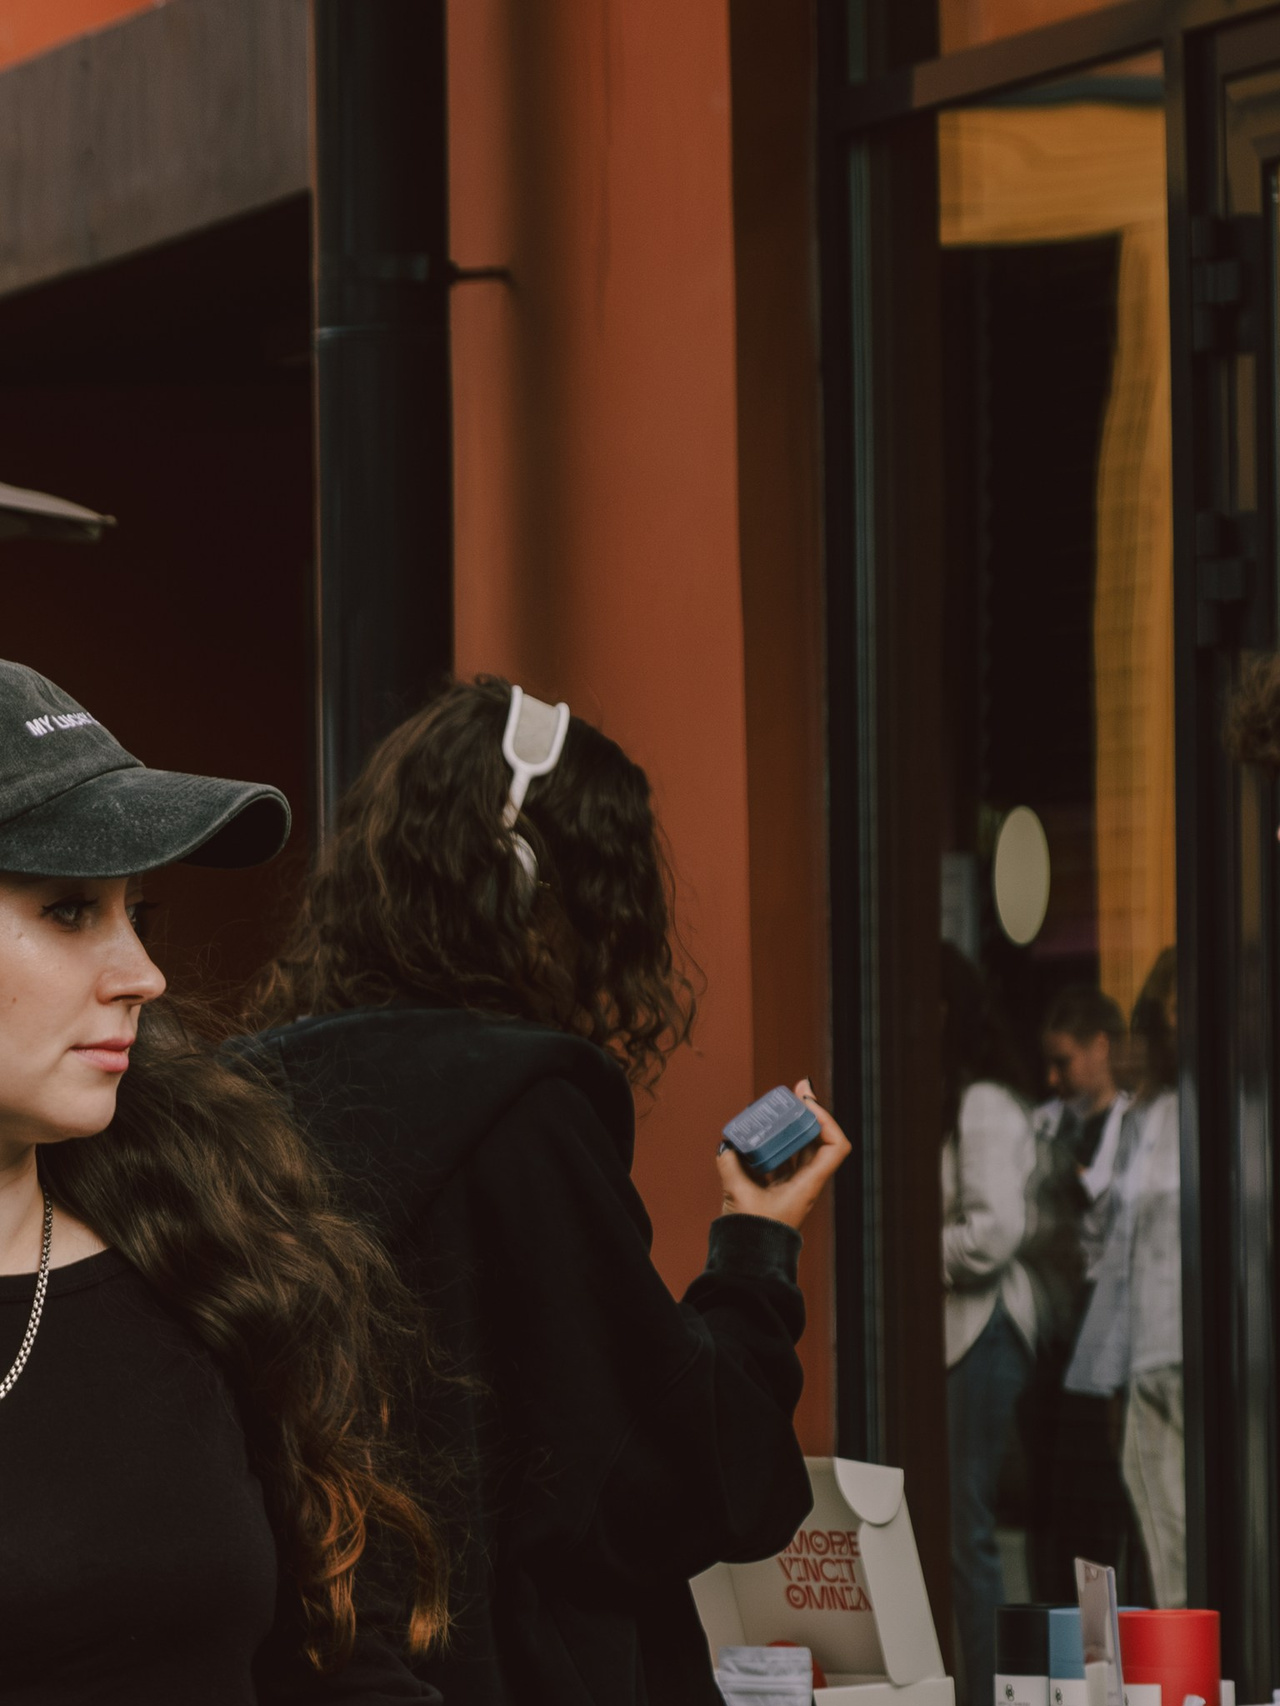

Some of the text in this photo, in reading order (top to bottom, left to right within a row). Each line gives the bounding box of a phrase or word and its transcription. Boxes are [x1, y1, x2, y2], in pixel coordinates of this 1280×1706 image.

[25, 714, 55, 736] MY
[783, 1529, 861, 1557] MORE
[777, 1556, 857, 1584] VINCIT
[785, 1584, 873, 1612] OMNIA
